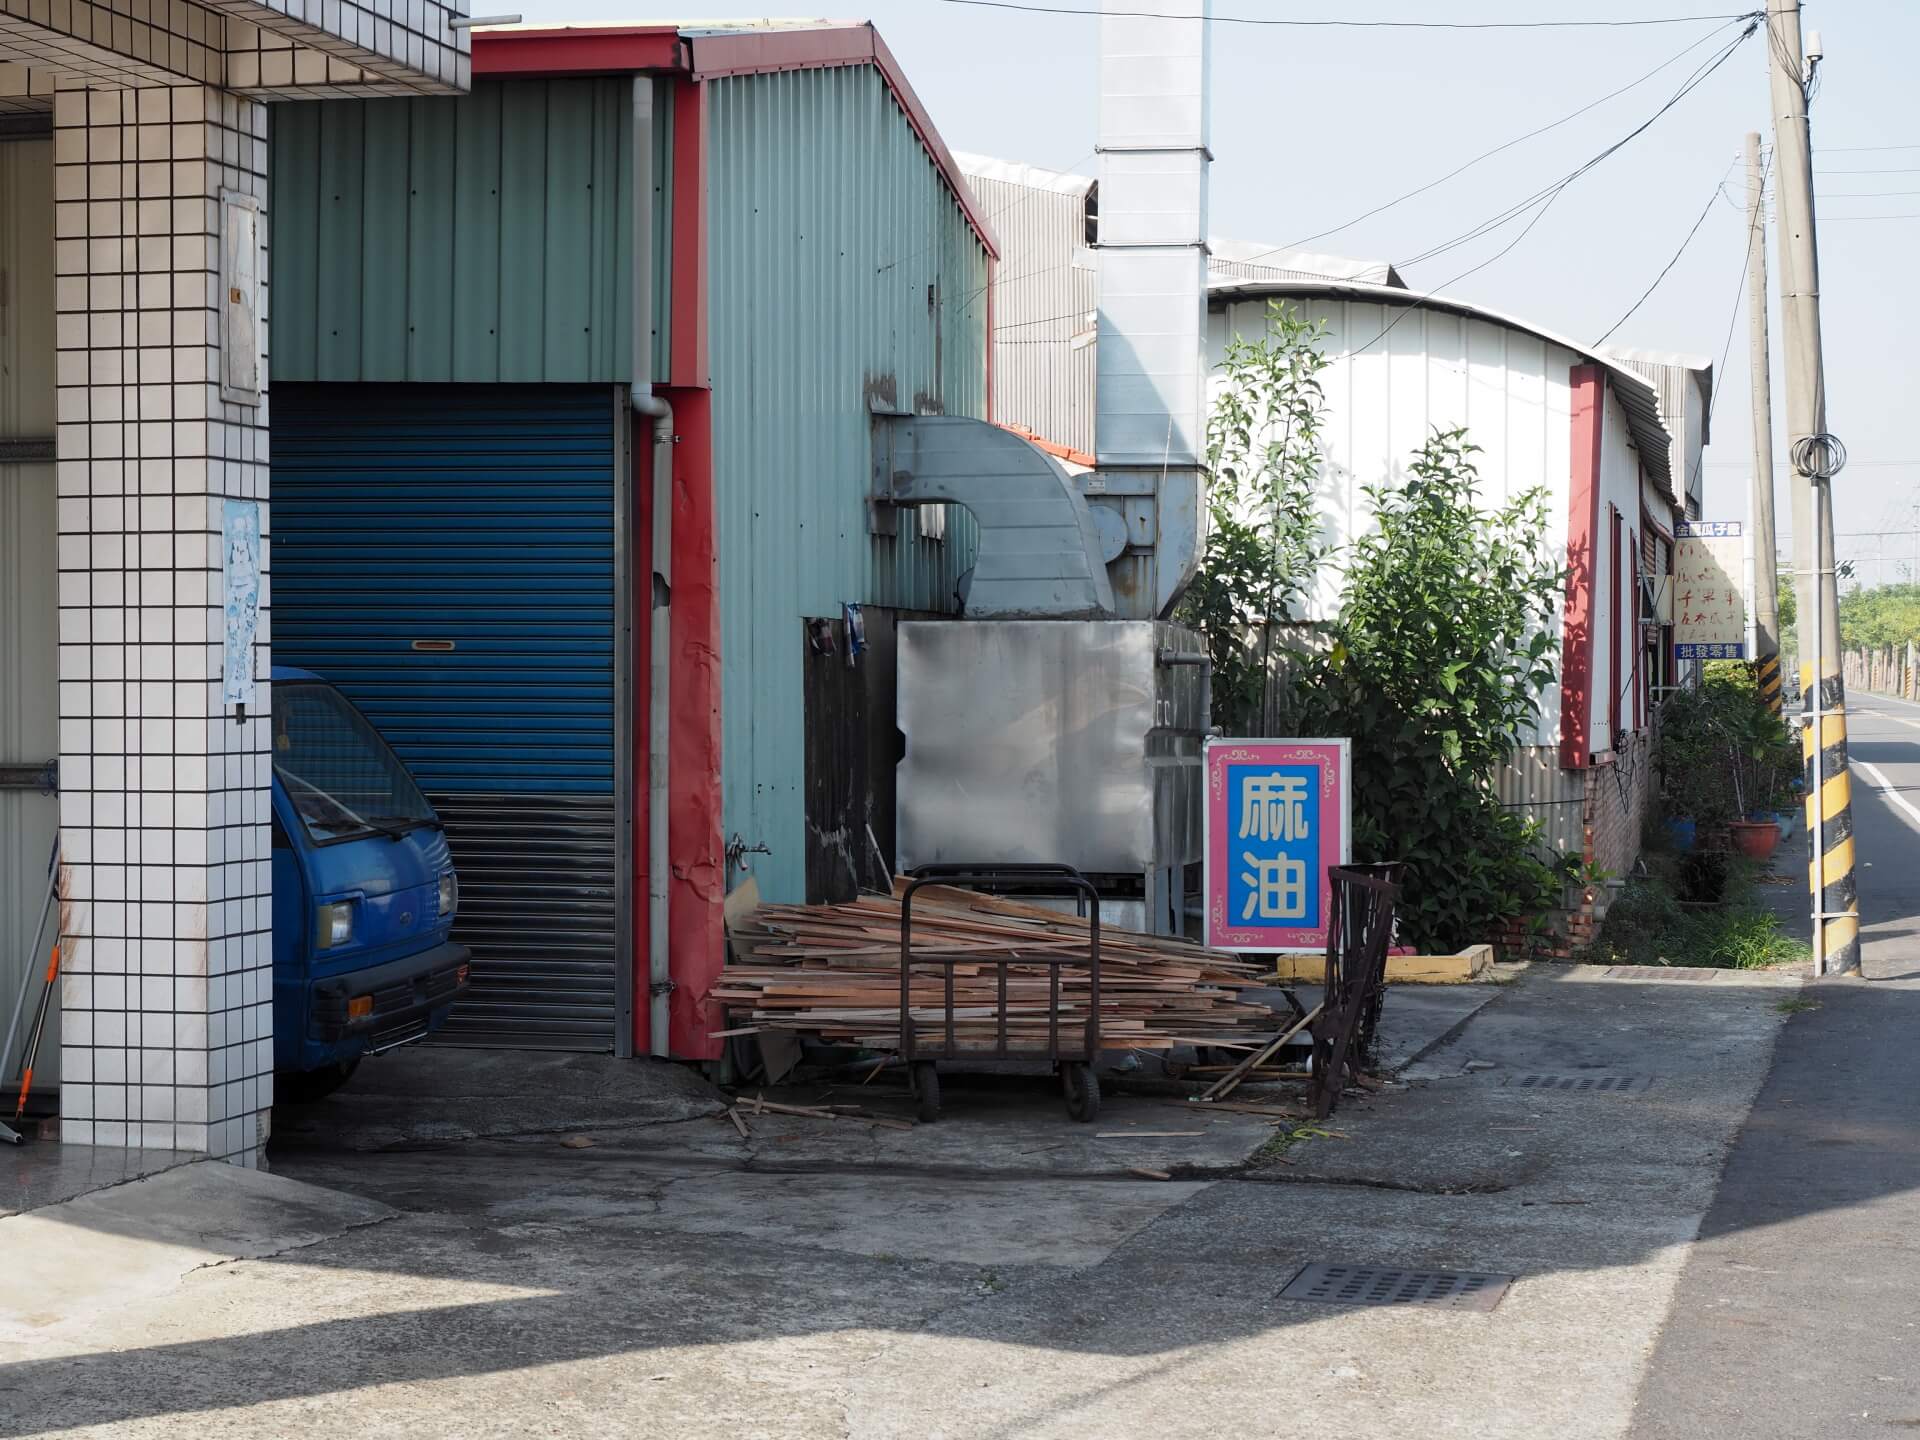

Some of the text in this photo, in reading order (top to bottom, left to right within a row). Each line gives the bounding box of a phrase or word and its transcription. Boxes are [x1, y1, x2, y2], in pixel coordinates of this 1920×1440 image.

[1680, 645, 1737, 658] 批發零售
[1239, 772, 1309, 920] 麻油
